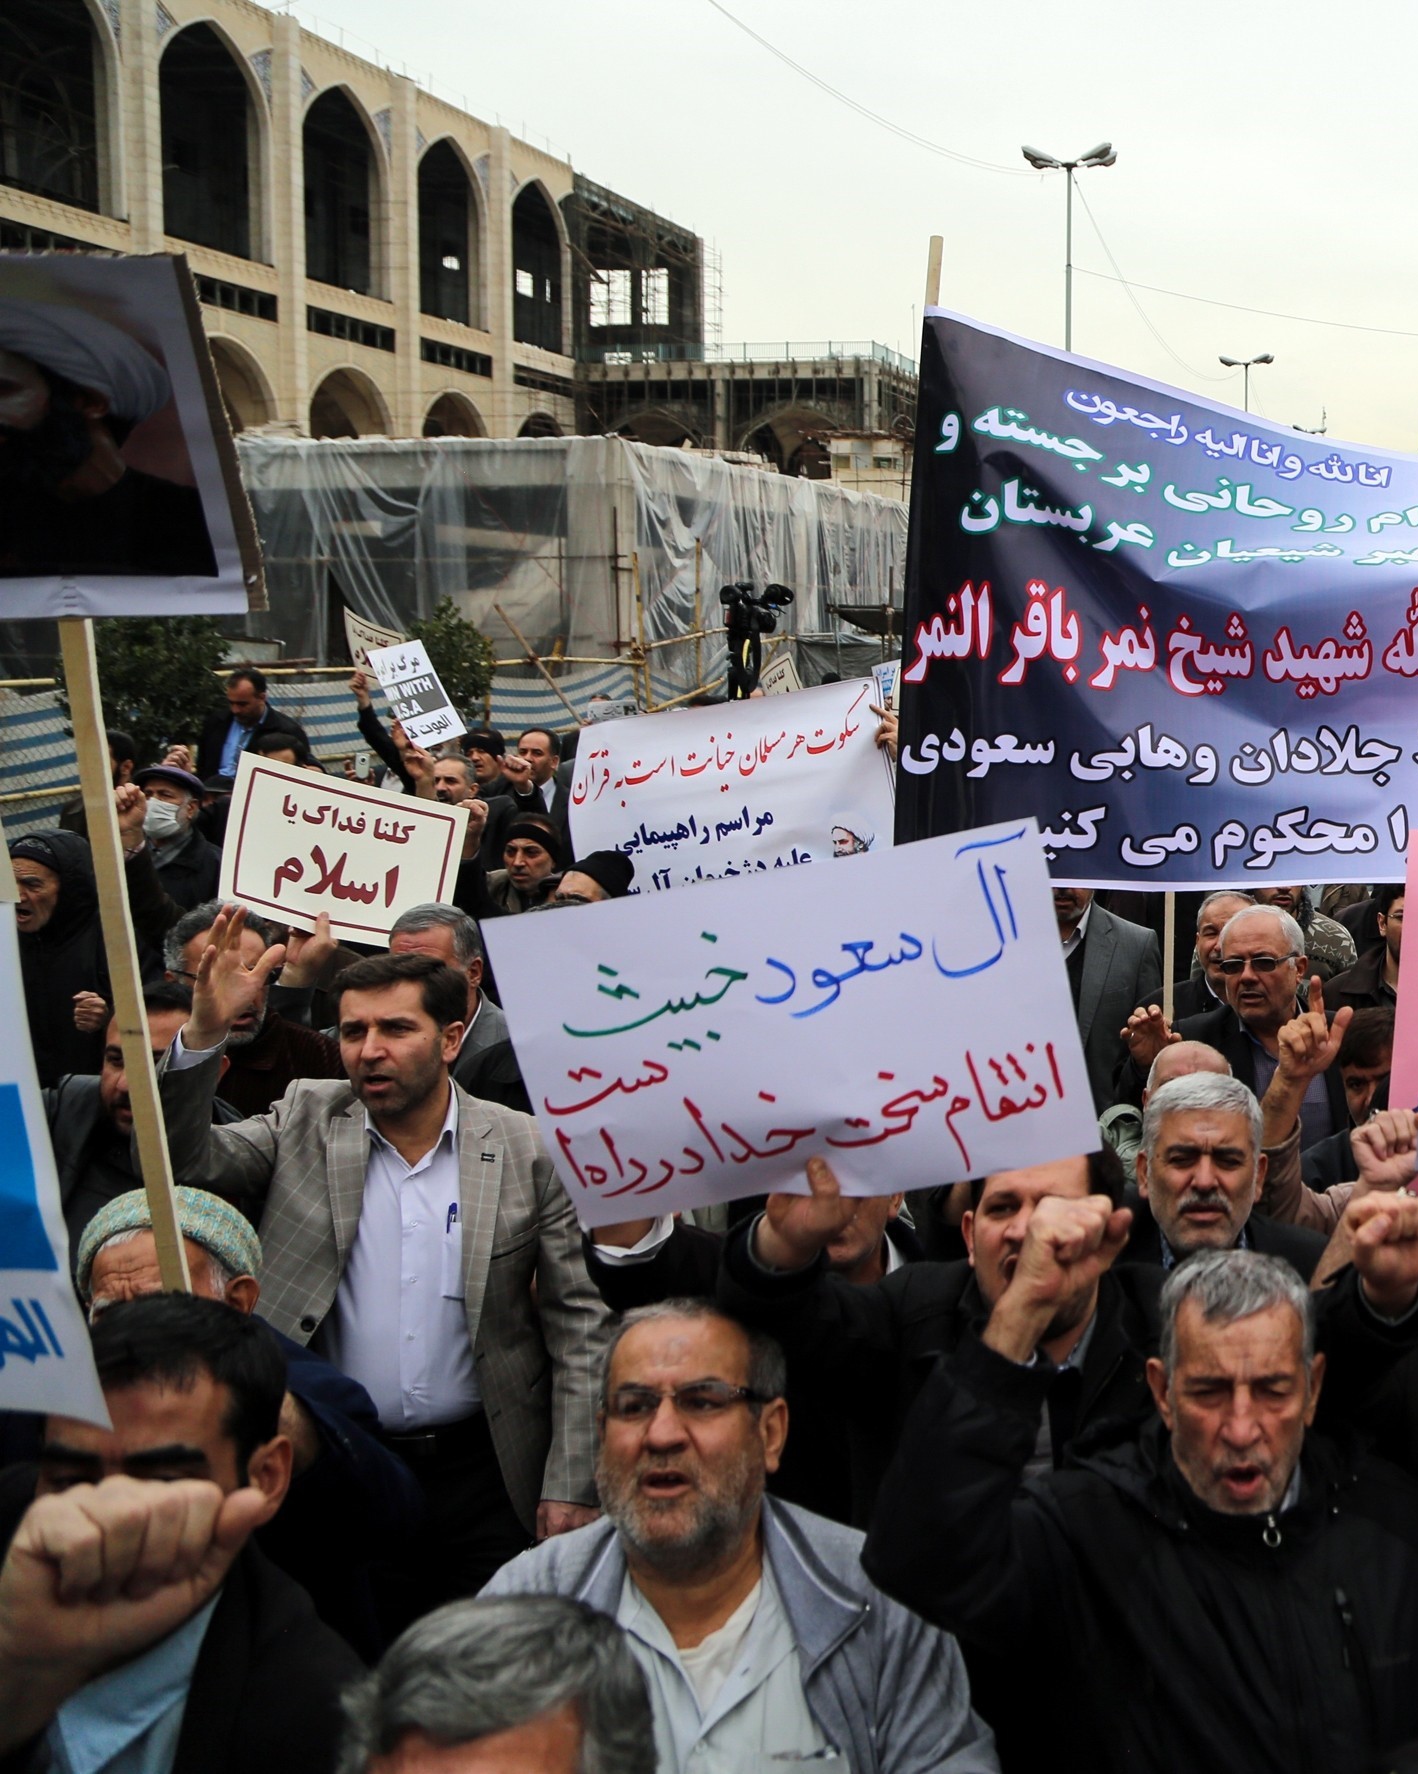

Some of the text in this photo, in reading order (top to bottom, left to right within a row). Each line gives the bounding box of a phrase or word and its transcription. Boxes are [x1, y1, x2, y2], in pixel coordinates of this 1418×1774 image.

[934, 410, 961, 454] و
[1062, 388, 1190, 445] راجعون
[1250, 438, 1282, 468] انا
[1278, 453, 1302, 479] و
[1162, 478, 1357, 533] روحانی
[1165, 538, 1345, 568] شیعیان
[902, 580, 993, 683] النمر
[998, 579, 1081, 684] باقر
[1088, 604, 1158, 690] نمر
[1166, 612, 1254, 697] شیخ
[1262, 610, 1373, 699] شهید
[394, 699, 424, 721] .S.A
[399, 676, 434, 698] WITH
[572, 688, 870, 807] سکوت هر مسلمان خیانت است به قرآن
[901, 727, 1056, 779] سعودی
[1229, 721, 1402, 787] جلادان
[282, 794, 416, 844] کلنا فداک یا
[716, 806, 774, 842] مراسم
[1039, 804, 1107, 861] کنی
[1120, 824, 1199, 867] می
[1212, 805, 1379, 869] محکوم
[273, 845, 399, 908] اسلام
[563, 827, 1027, 1051] آل سعود خبیث
[683, 1091, 816, 1165] خدا
[825, 1070, 950, 1148] سخت
[945, 1042, 1065, 1172] انتقام
